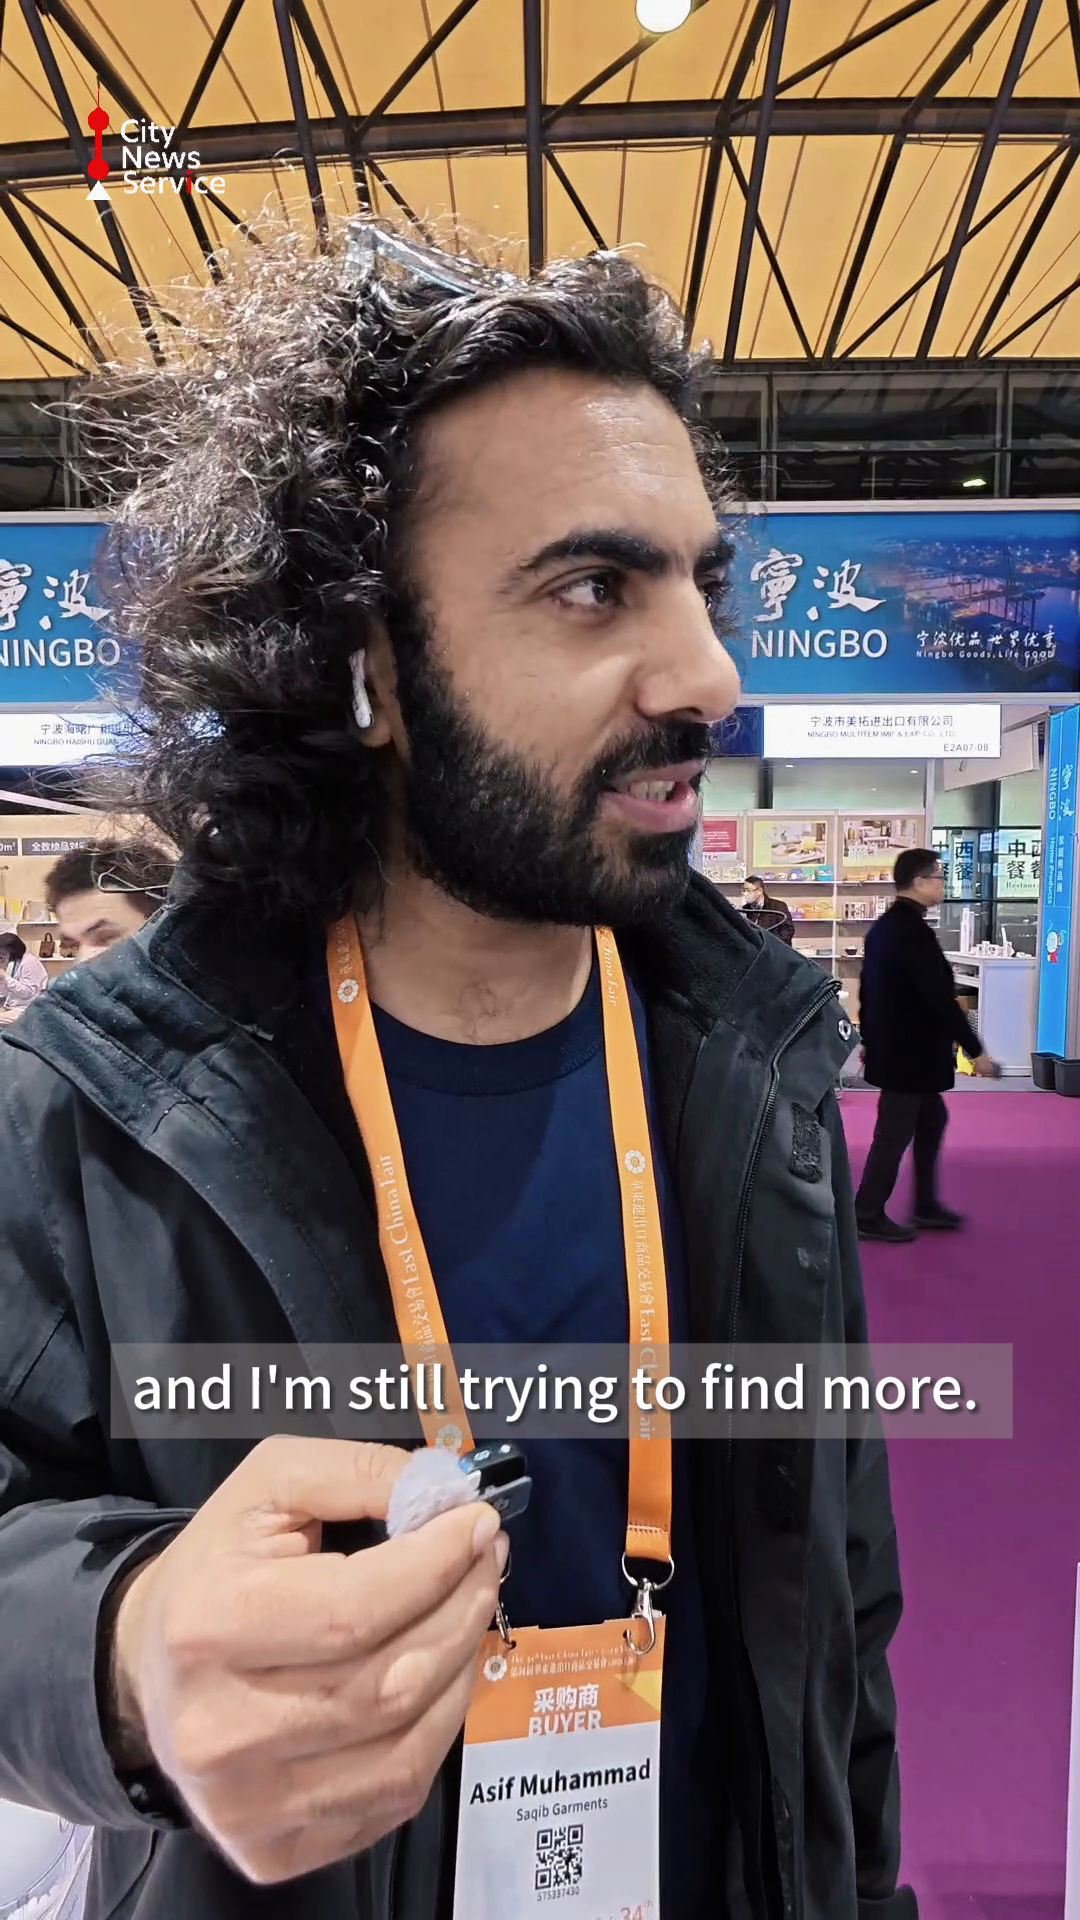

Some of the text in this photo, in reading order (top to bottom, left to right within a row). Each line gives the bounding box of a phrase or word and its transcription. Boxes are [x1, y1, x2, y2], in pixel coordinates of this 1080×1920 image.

[751, 628, 888, 659] NINGBO
[916, 650, 954, 659] Ningbo
[1049, 767, 1058, 820] NINGBO
[376, 1153, 397, 1188] Fair
[386, 1187, 409, 1246] China
[398, 1246, 420, 1286] East
[640, 1308, 655, 1343] East
[533, 1683, 600, 1713] 采购商
[528, 1709, 602, 1737] BUYER
[469, 1757, 651, 1806] Asif Muhammad
[516, 1798, 608, 1822] Saqib Garments
